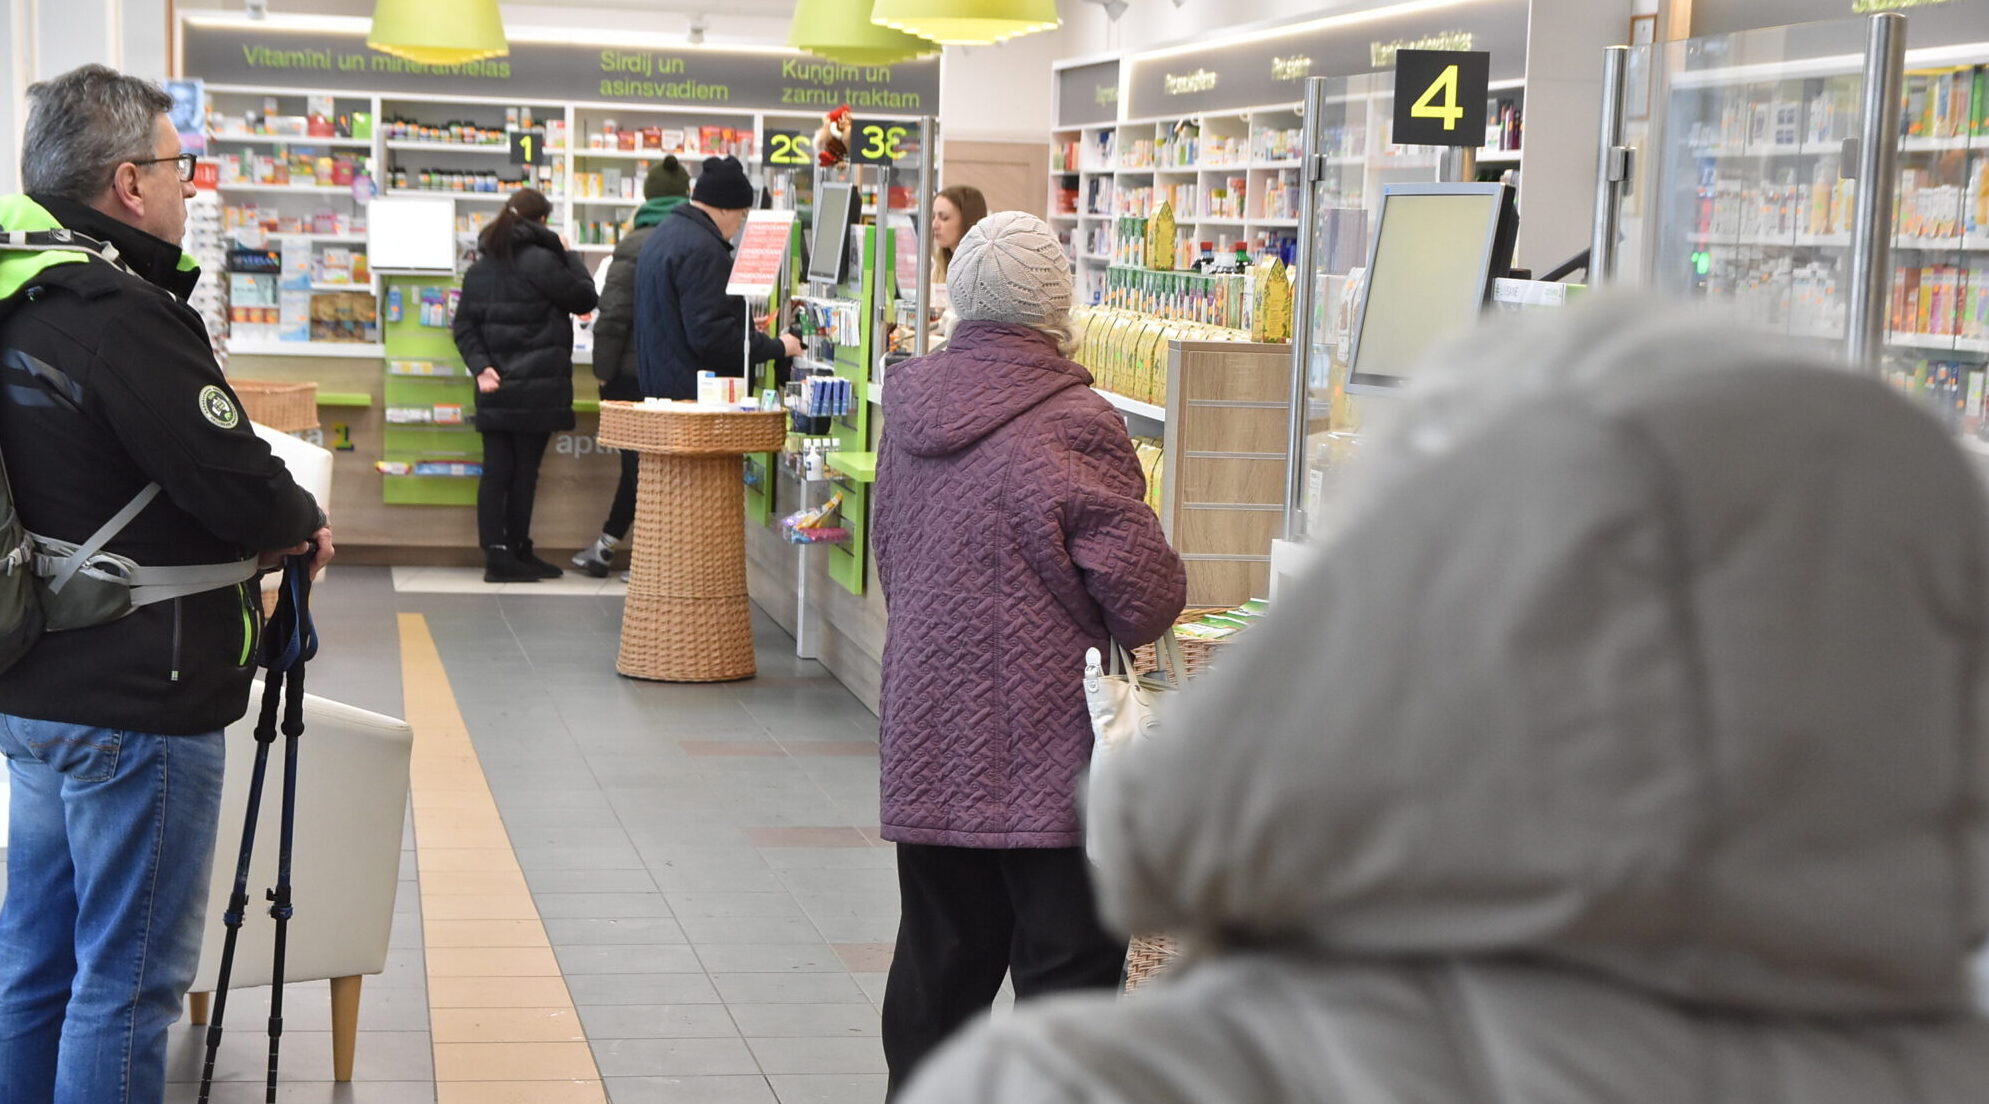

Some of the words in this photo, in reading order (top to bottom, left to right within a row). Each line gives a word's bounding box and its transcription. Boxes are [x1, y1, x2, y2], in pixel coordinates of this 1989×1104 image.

[338, 53, 366, 72] un
[600, 51, 652, 77] Sirdij
[658, 57, 685, 74] un
[865, 66, 890, 83] un
[600, 76, 729, 100] asinsvadiem
[781, 87, 838, 105] zarnu
[845, 87, 920, 109] traktam
[1411, 65, 1463, 130] 4
[519, 135, 532, 162] 1
